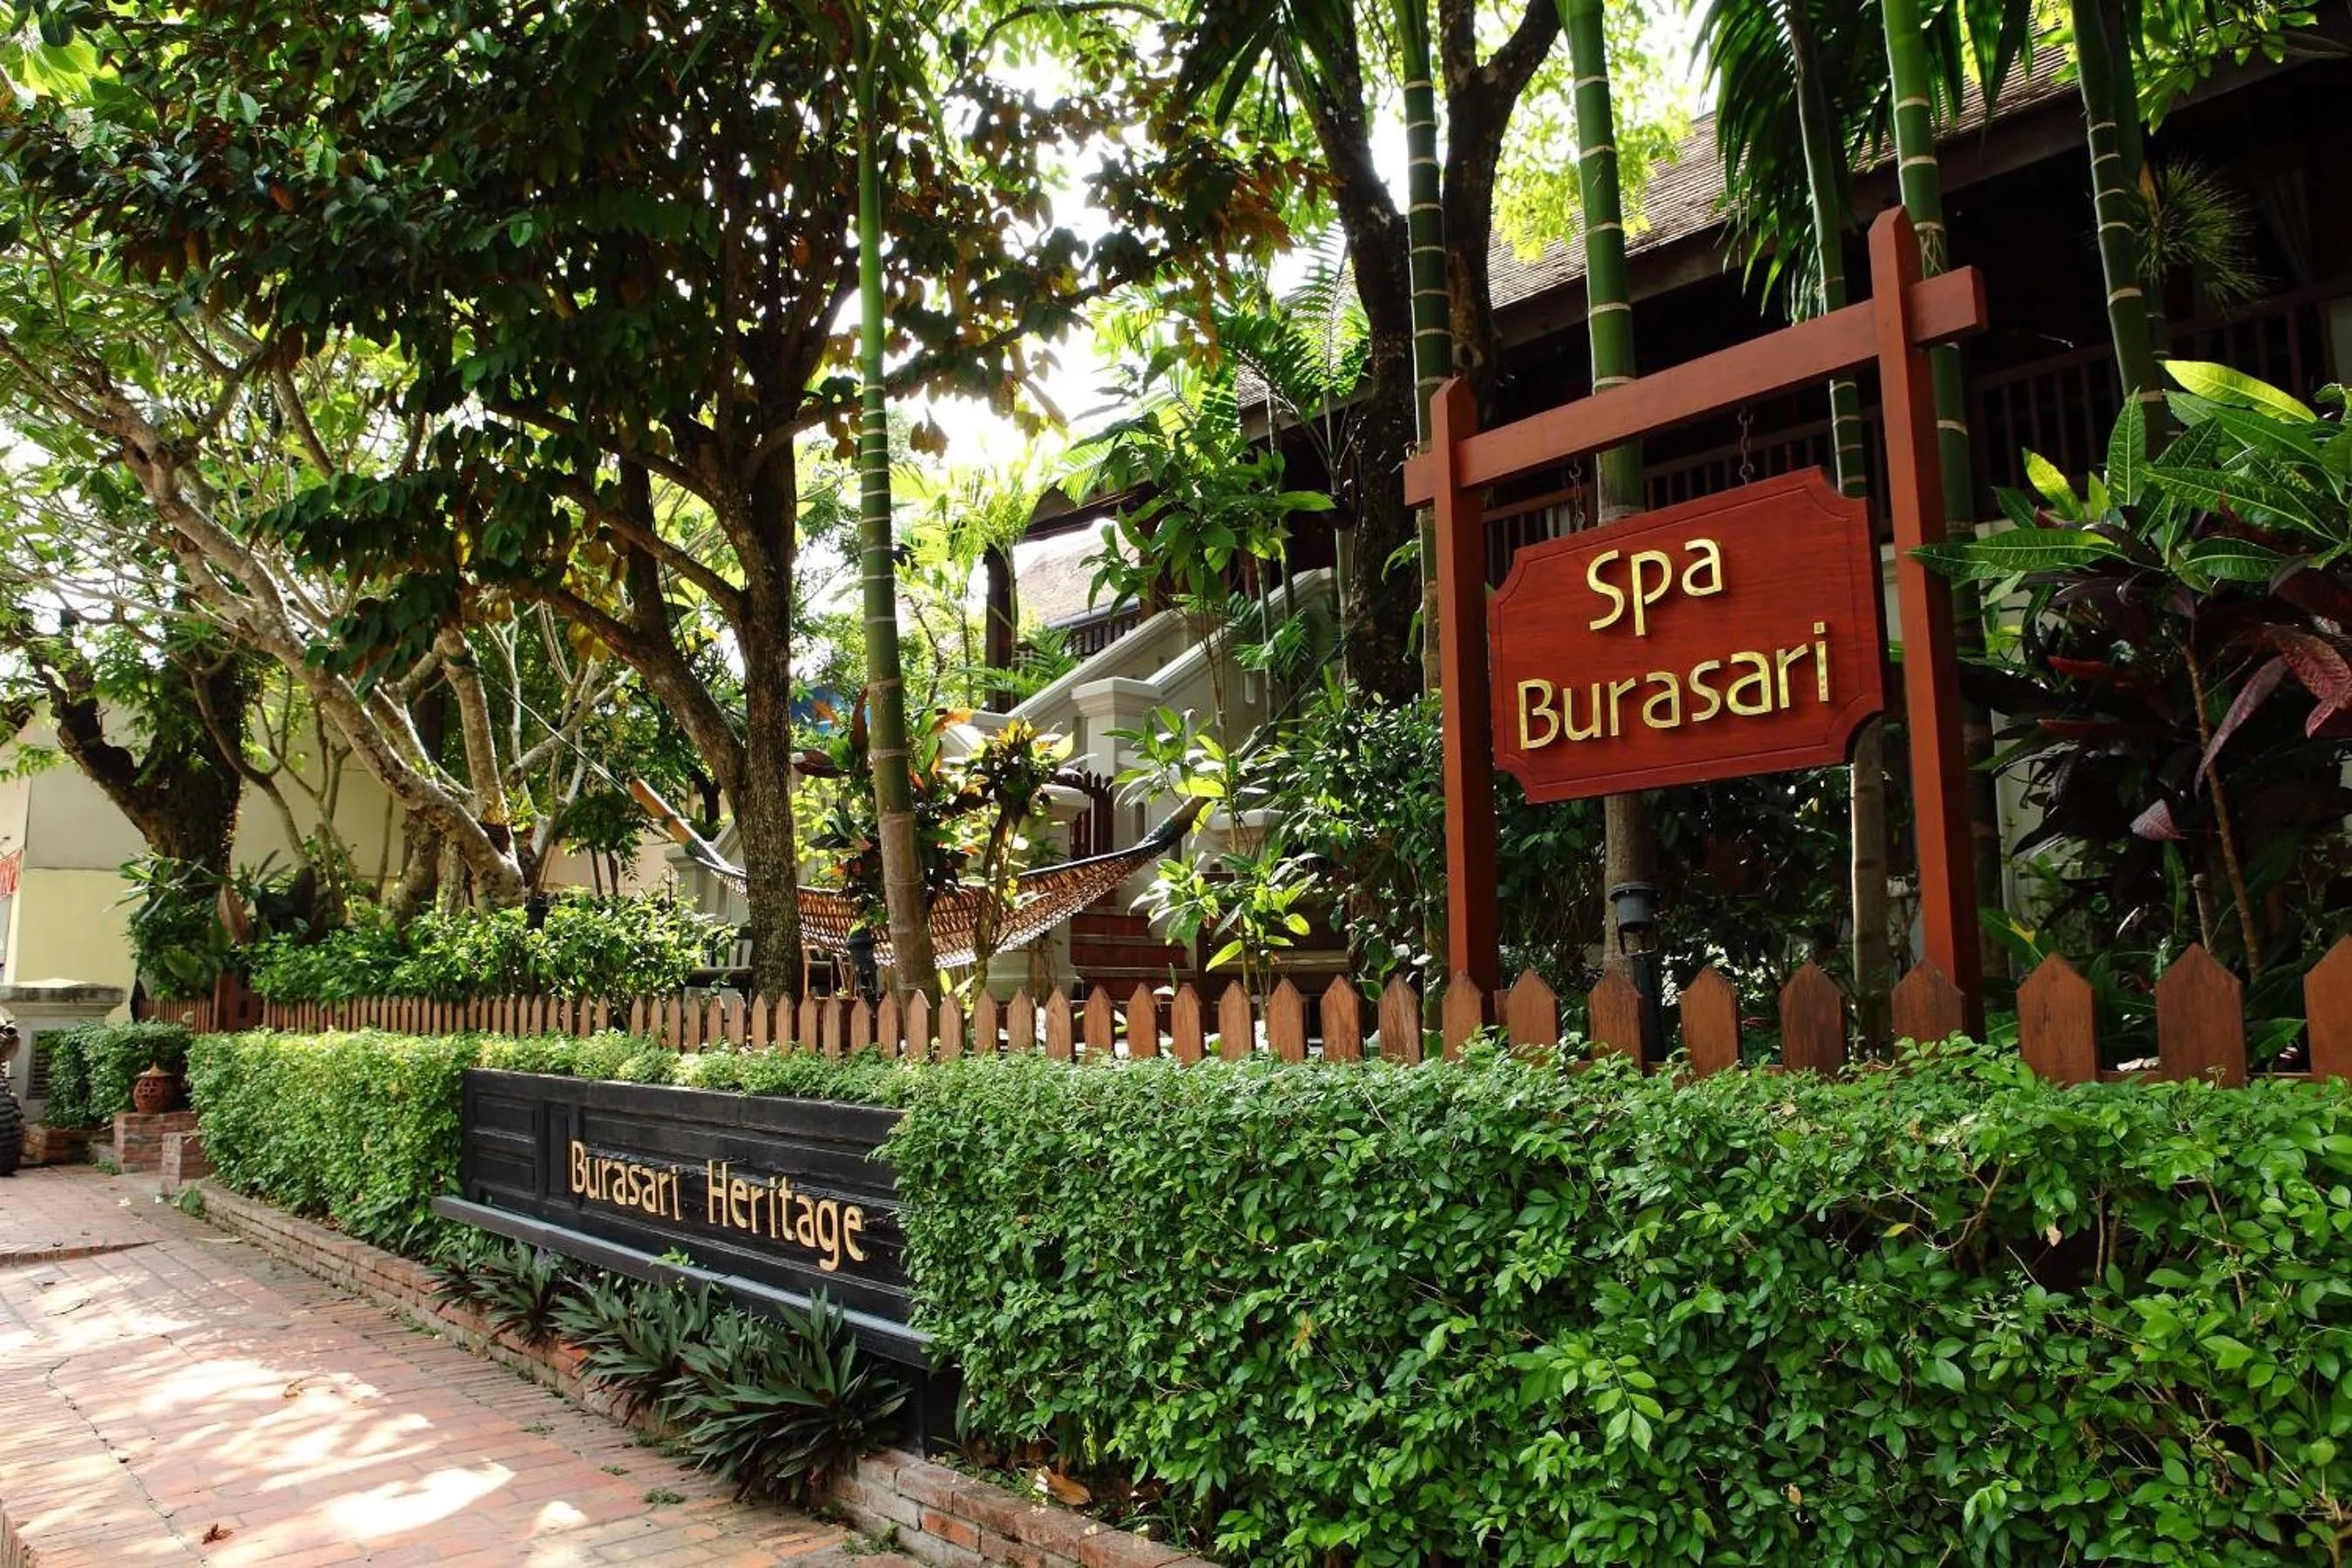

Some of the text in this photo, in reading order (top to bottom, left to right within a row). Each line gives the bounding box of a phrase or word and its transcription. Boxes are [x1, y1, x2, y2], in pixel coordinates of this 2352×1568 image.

[1585, 537, 1723, 636] Spa
[1517, 621, 1829, 750] Burasari
[571, 1140, 867, 1272] Burasari Heritage
